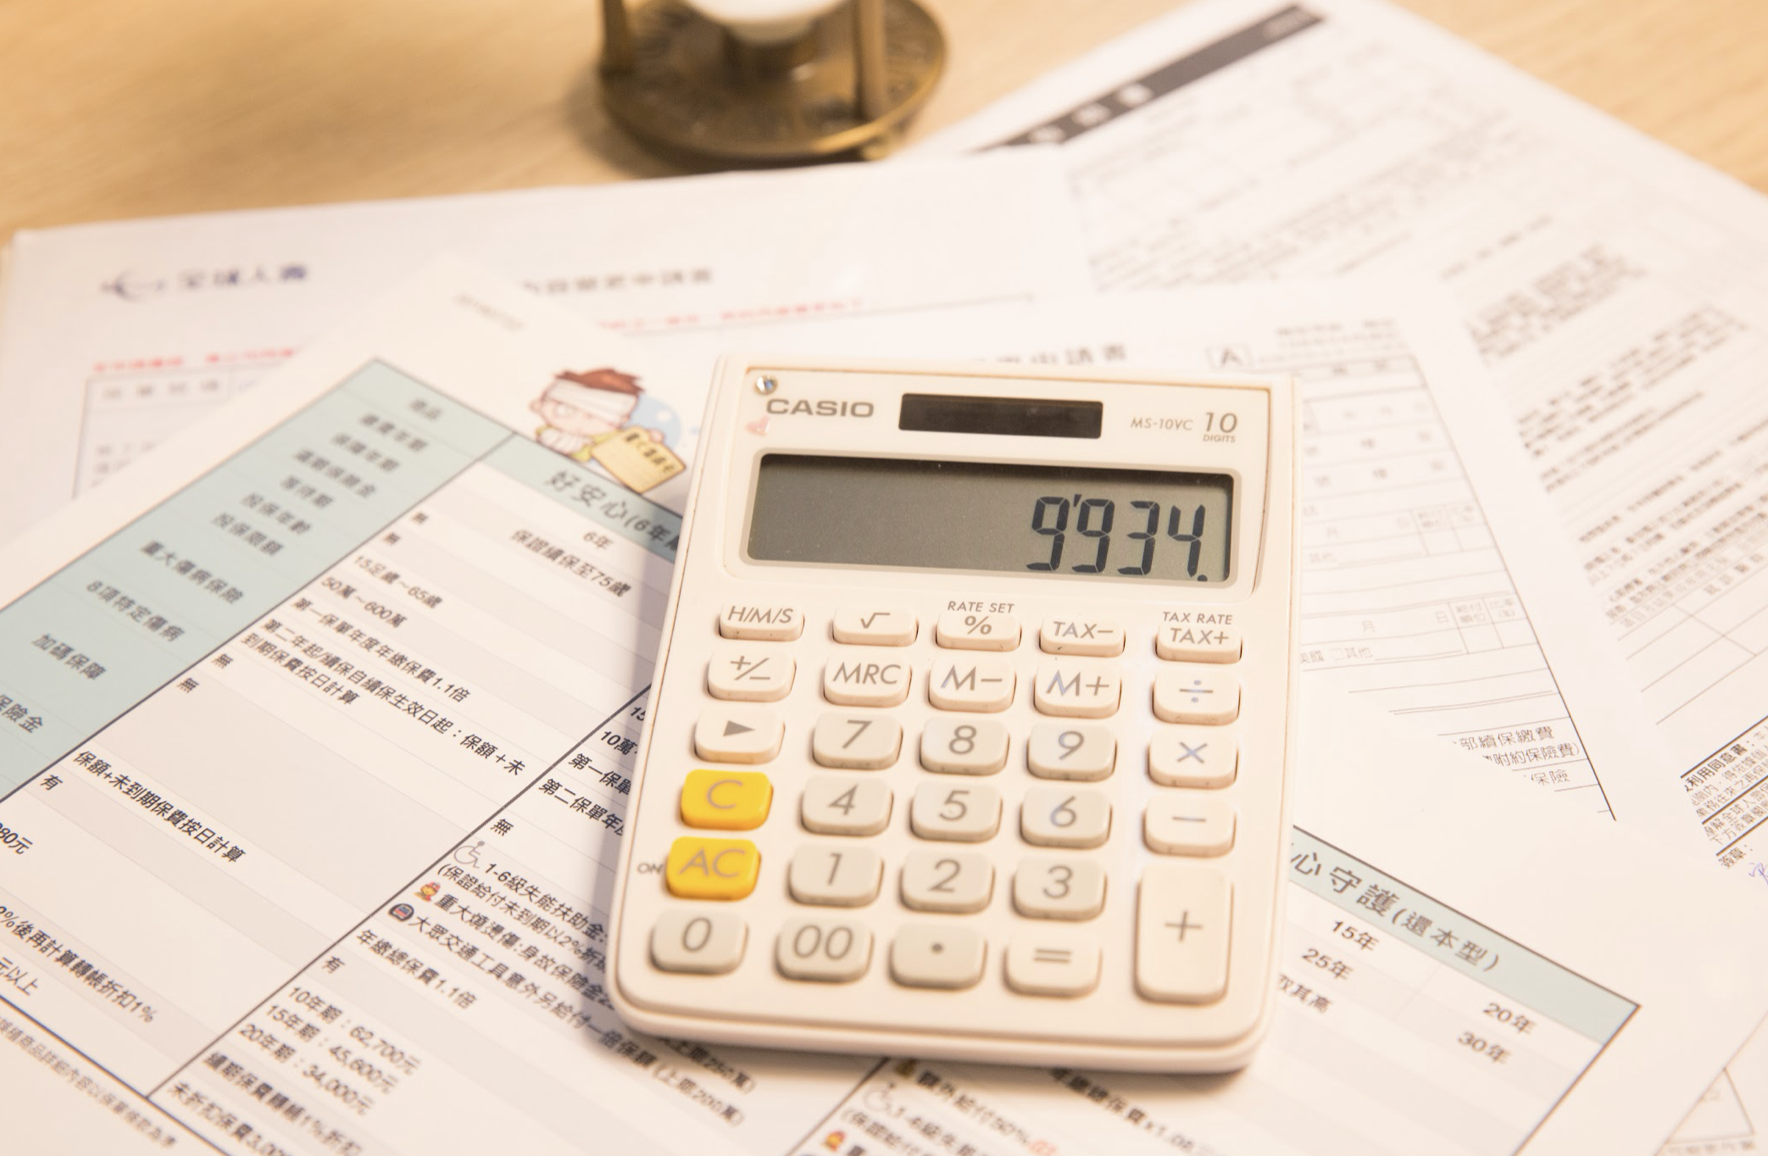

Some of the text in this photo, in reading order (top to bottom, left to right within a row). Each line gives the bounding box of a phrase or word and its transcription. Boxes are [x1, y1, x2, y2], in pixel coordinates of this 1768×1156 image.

[765, 398, 875, 419] CASIO
[1130, 411, 1238, 434] MS-10VC 10
[1202, 433, 1237, 444] DIGITS
[727, 606, 795, 627] H/M/S
[947, 601, 1015, 615] RATE SET
[1162, 611, 1234, 625] TAX RATE
[1171, 628, 1230, 646] TAX+
[31, 633, 107, 681] 加碼保障
[211, 652, 234, 669] 無
[175, 676, 200, 694] 無
[833, 663, 901, 685] MRC
[1045, 671, 1110, 697] M+
[600, 730, 639, 756] 10萬
[845, 720, 873, 749] 7
[949, 725, 976, 755] 8
[1058, 730, 1085, 761] 9
[1483, 742, 1580, 767] 附約保險費)
[39, 774, 64, 791] 有
[706, 779, 744, 810] C
[829, 784, 858, 815] 4
[939, 789, 968, 821] 5
[1050, 796, 1077, 827] 6
[0, 822, 34, 855] 80元
[490, 818, 514, 836] 無
[637, 862, 663, 876] ON
[679, 848, 746, 879] AC
[825, 853, 842, 886] 1
[929, 859, 962, 892] 2
[1042, 866, 1074, 899] 3
[682, 916, 712, 951] 0
[792, 924, 854, 961] 00
[1332, 920, 1380, 951] 15年
[1301, 947, 1354, 981] 25年
[1482, 1002, 1538, 1034] 20年
[1457, 1031, 1512, 1064] 30年
